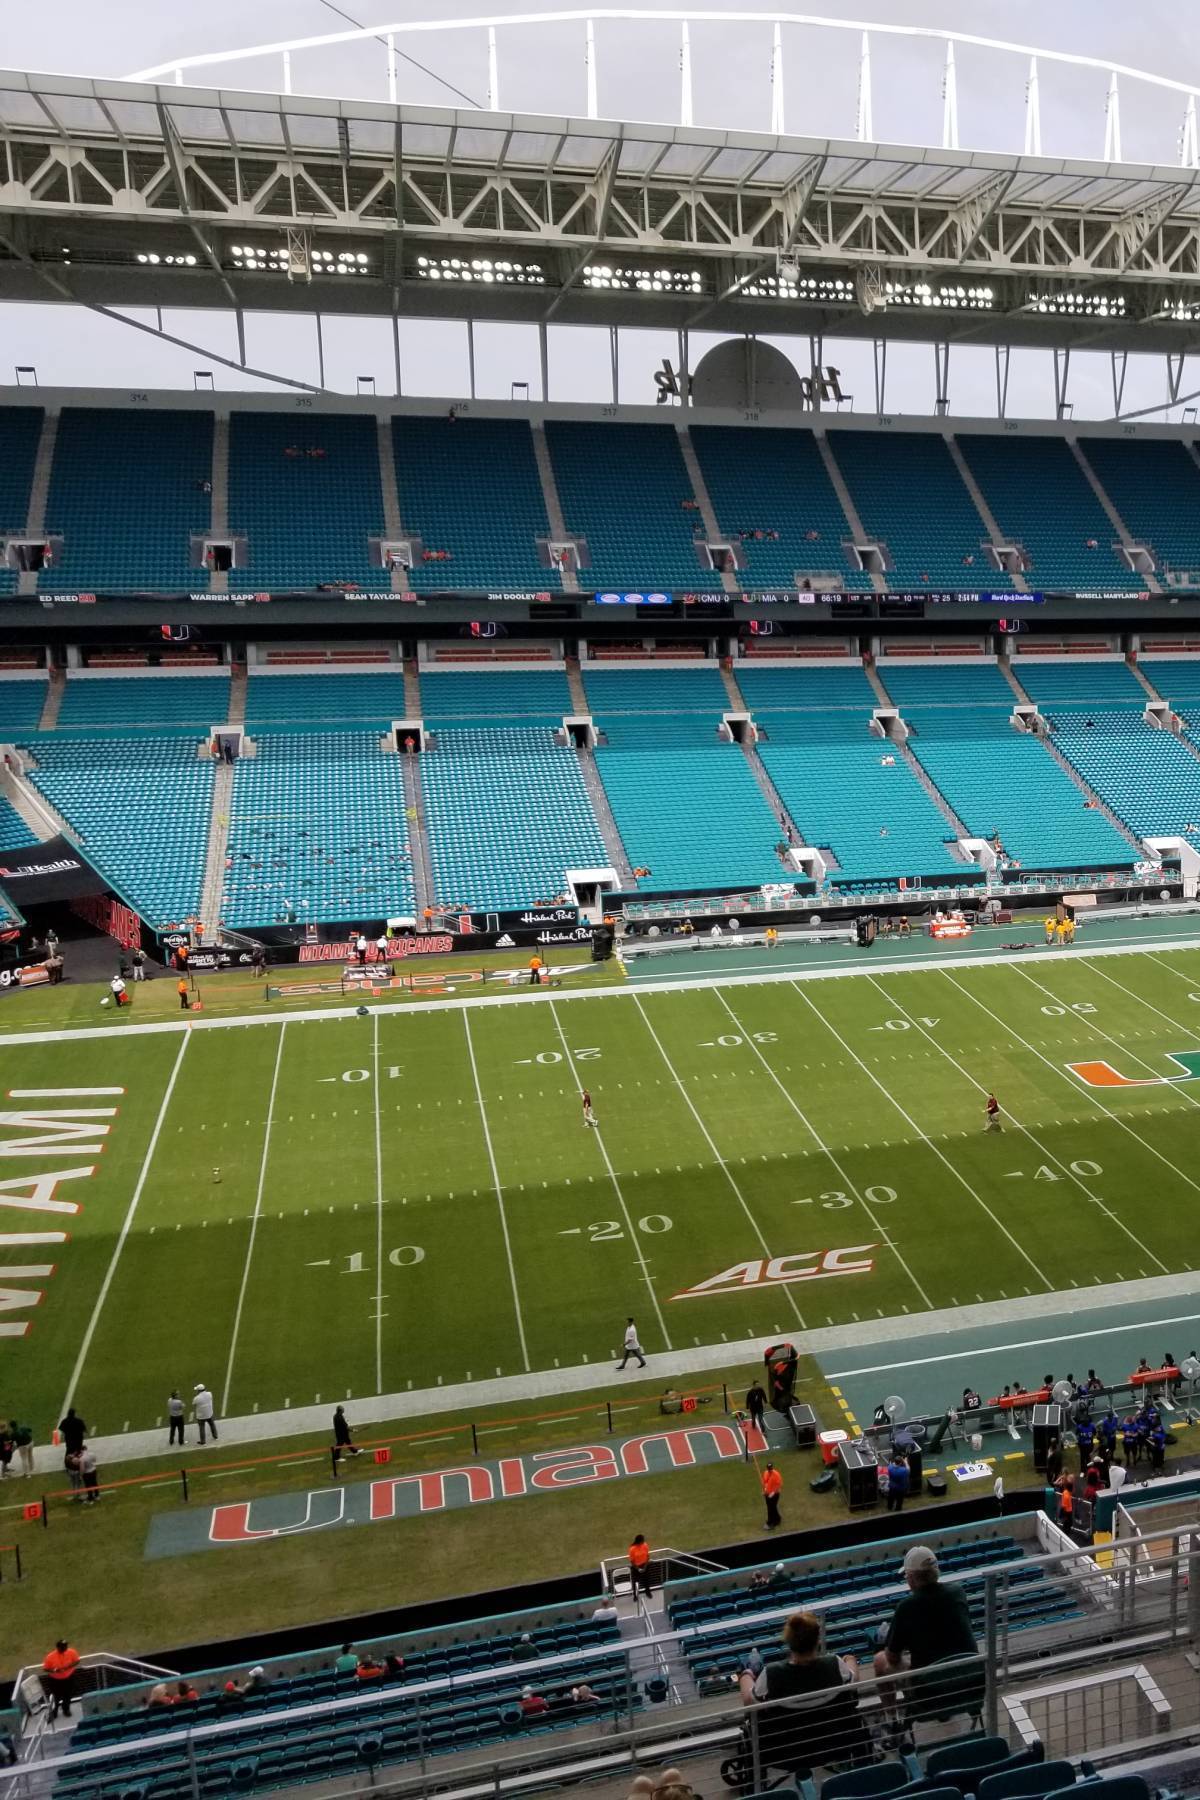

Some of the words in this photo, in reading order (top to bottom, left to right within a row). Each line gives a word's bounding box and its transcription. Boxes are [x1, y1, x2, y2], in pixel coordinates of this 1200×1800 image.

[702, 594, 721, 602] CMU
[762, 594, 777, 602] MIA
[904, 594, 912, 602] 10
[942, 594, 951, 602] 25
[555, 909, 576, 920] Park
[298, 941, 355, 963] MIAMI
[357, 936, 454, 958] URICANES
[1039, 1002, 1100, 1017] 50
[884, 1016, 942, 1032] 40
[718, 1031, 779, 1047] 30
[536, 1047, 603, 1064] 20
[341, 1065, 405, 1083] 10
[1033, 1159, 1104, 1182] 40
[818, 1185, 898, 1209] 30
[587, 1213, 673, 1242] 20
[340, 1245, 425, 1274] 10
[665, 1243, 882, 1301] ACC
[685, 1399, 695, 1411] 20
[967, 1398, 979, 1408] 22
[377, 1450, 388, 1462] 10
[208, 1487, 345, 1542] U
